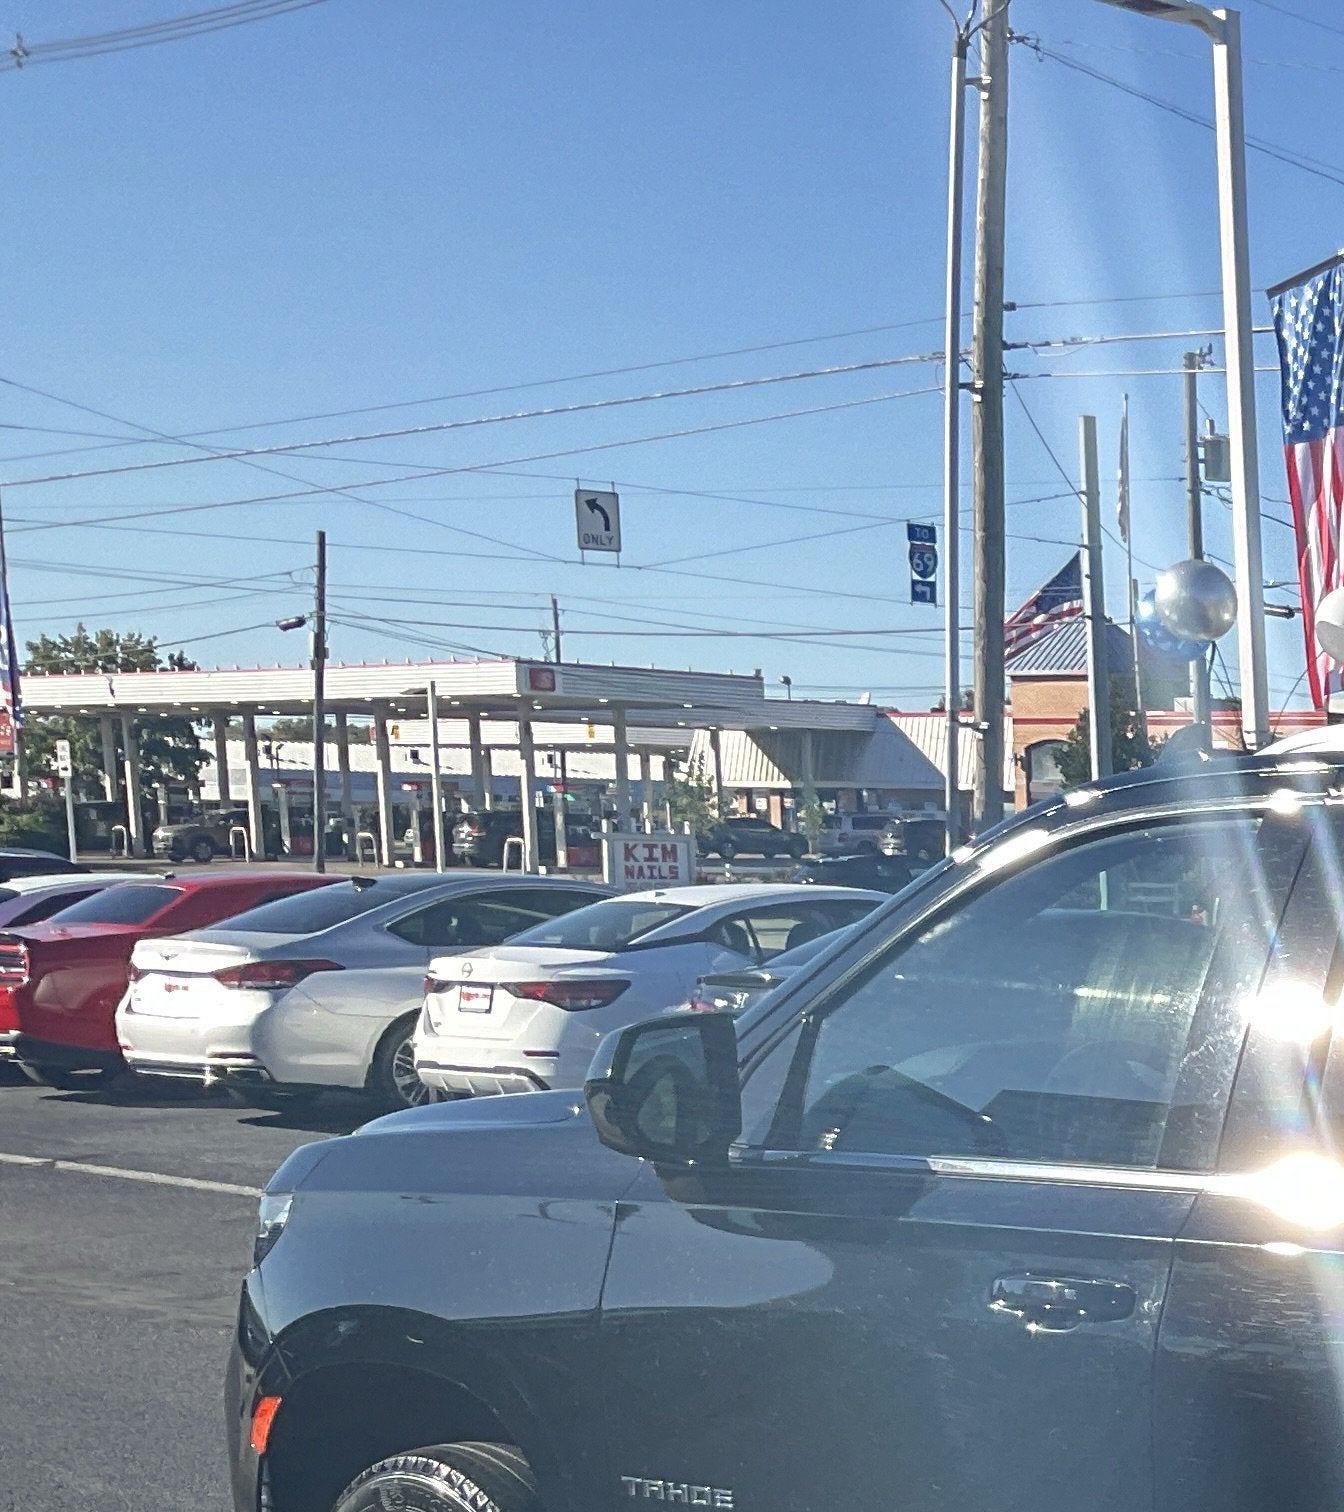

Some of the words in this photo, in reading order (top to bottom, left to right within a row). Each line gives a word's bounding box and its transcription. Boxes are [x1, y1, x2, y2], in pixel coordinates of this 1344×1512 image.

[583, 533, 614, 546] ONLY
[914, 527, 930, 539] TO
[912, 552, 934, 573] 69
[623, 842, 679, 863] KIM
[624, 864, 680, 880] NAILS
[620, 1474, 735, 1510] TAHOE
